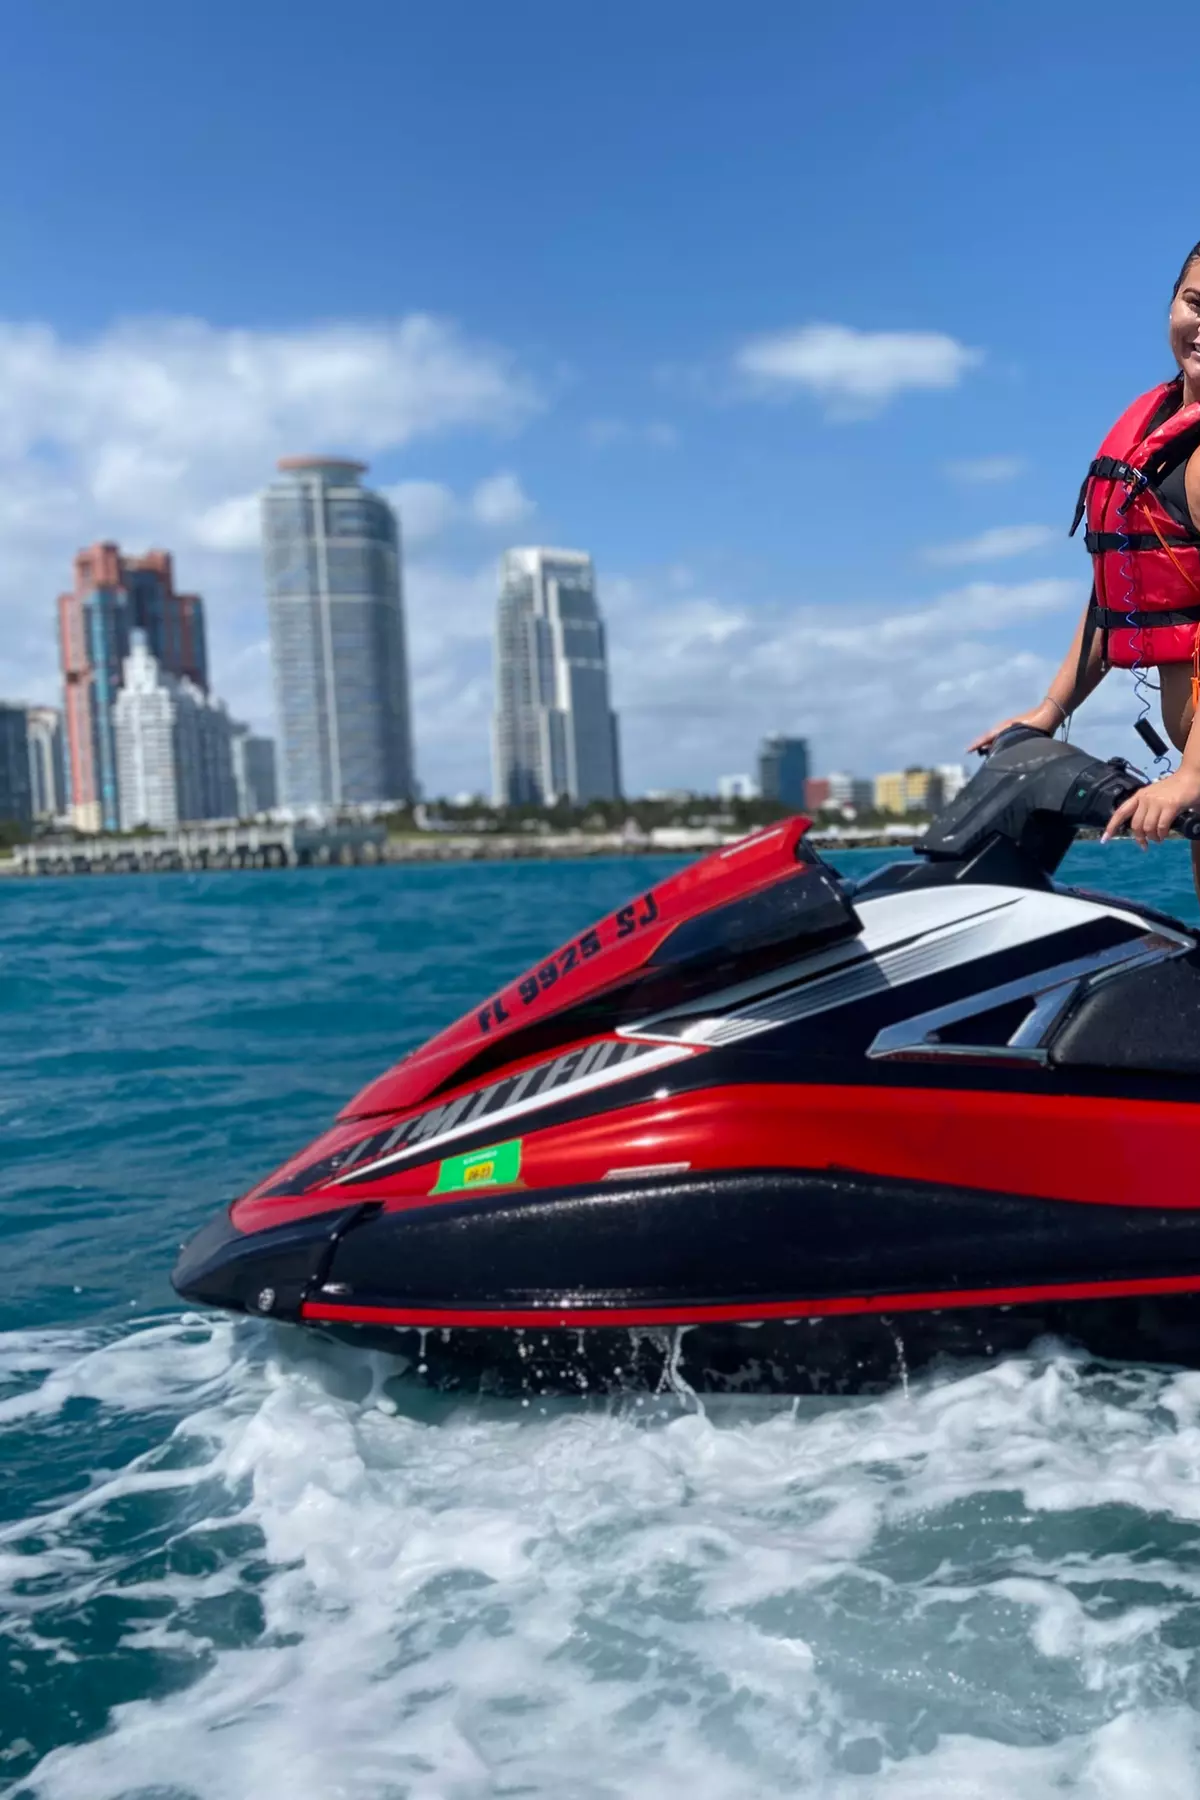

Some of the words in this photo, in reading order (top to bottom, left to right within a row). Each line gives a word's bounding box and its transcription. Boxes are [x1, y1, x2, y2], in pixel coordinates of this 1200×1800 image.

[478, 999, 509, 1033] FL
[518, 930, 602, 1005] 9925
[616, 892, 658, 938] SJ
